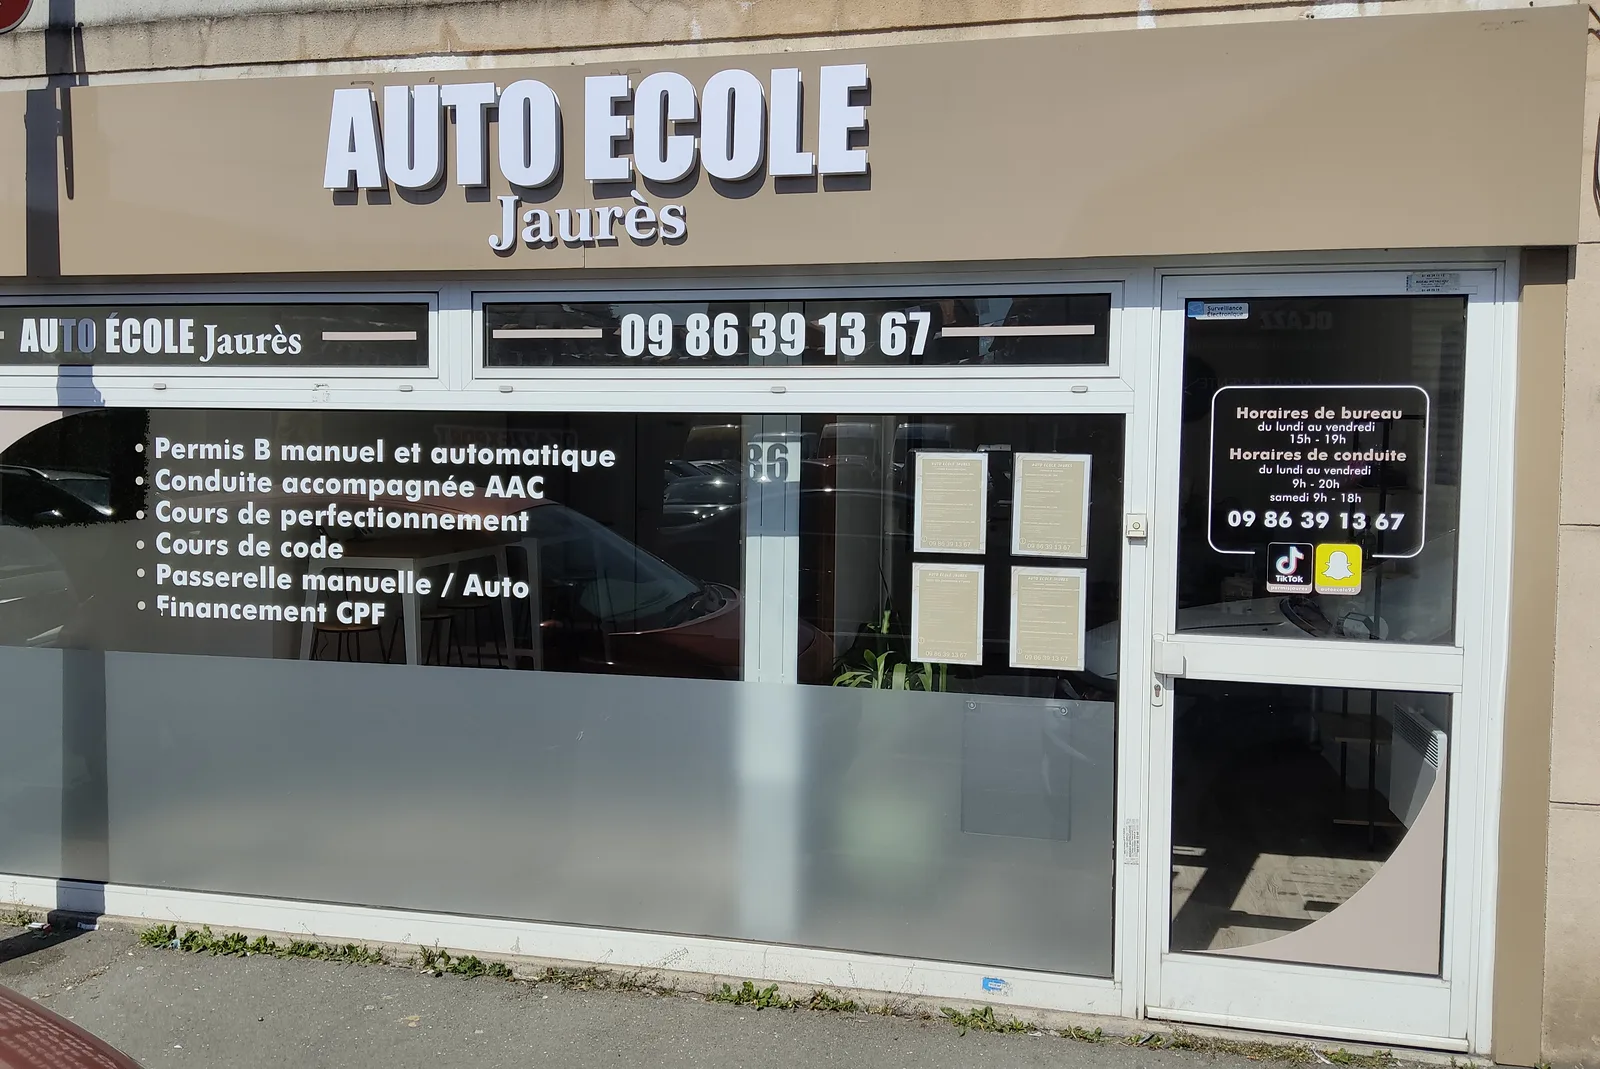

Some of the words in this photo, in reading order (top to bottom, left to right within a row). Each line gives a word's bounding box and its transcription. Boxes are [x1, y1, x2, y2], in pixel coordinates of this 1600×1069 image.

[323, 79, 561, 190] AUTO
[584, 63, 869, 183] ECOLE
[488, 189, 688, 251] Jaurès
[20, 317, 96, 354] AUTO
[105, 312, 195, 354] ÉCOLE
[199, 324, 302, 362] Jaurès
[620, 313, 673, 357] 09
[685, 312, 739, 357] 86
[751, 312, 806, 357] 39
[818, 312, 866, 356] 13
[880, 311, 931, 356] 67
[1236, 406, 1309, 420] Horaires
[1314, 406, 1336, 420] de
[1341, 406, 1403, 420] bureau
[1257, 421, 1272, 432] du
[1276, 421, 1304, 432] lundi
[1307, 424, 1322, 432] au
[1325, 421, 1376, 432] vendredi
[1289, 433, 1311, 444] 15h
[1325, 433, 1347, 445] 19h
[155, 437, 244, 462] Permis
[254, 438, 271, 460] B
[281, 439, 385, 463] manuel
[394, 442, 421, 464] et
[430, 443, 616, 473] automatique
[1229, 447, 1302, 461] Horaires
[1307, 447, 1329, 461] de
[1333, 448, 1407, 462] conduite
[1258, 464, 1273, 475] du
[1276, 464, 1303, 475] lundi
[1306, 467, 1321, 475] au
[1323, 464, 1371, 476] vendredi
[1292, 478, 1307, 489] 9h
[1318, 478, 1340, 489] 20h
[155, 468, 272, 494] Conduite
[282, 474, 475, 502] accompagnée
[484, 475, 544, 500] AAC
[1269, 492, 1310, 503] samedi
[1313, 493, 1328, 504] 9h
[1340, 493, 1362, 504] 18h
[155, 501, 229, 525] Cours
[237, 502, 270, 526] de
[280, 503, 529, 532] perfectionnement
[1227, 510, 1256, 527] 09
[1263, 511, 1293, 529] 86
[1300, 511, 1330, 529] 39
[1339, 512, 1367, 530] 13
[1375, 513, 1405, 531] 67
[155, 532, 229, 557] Cours
[237, 533, 270, 557] de
[280, 535, 344, 560] code
[156, 563, 292, 590] Passerelle
[302, 569, 432, 596] manuelle
[441, 572, 455, 598] /
[463, 573, 530, 599] Auto
[1275, 574, 1304, 583] TikTok
[156, 596, 327, 624] Financement
[336, 602, 386, 625] CPF
